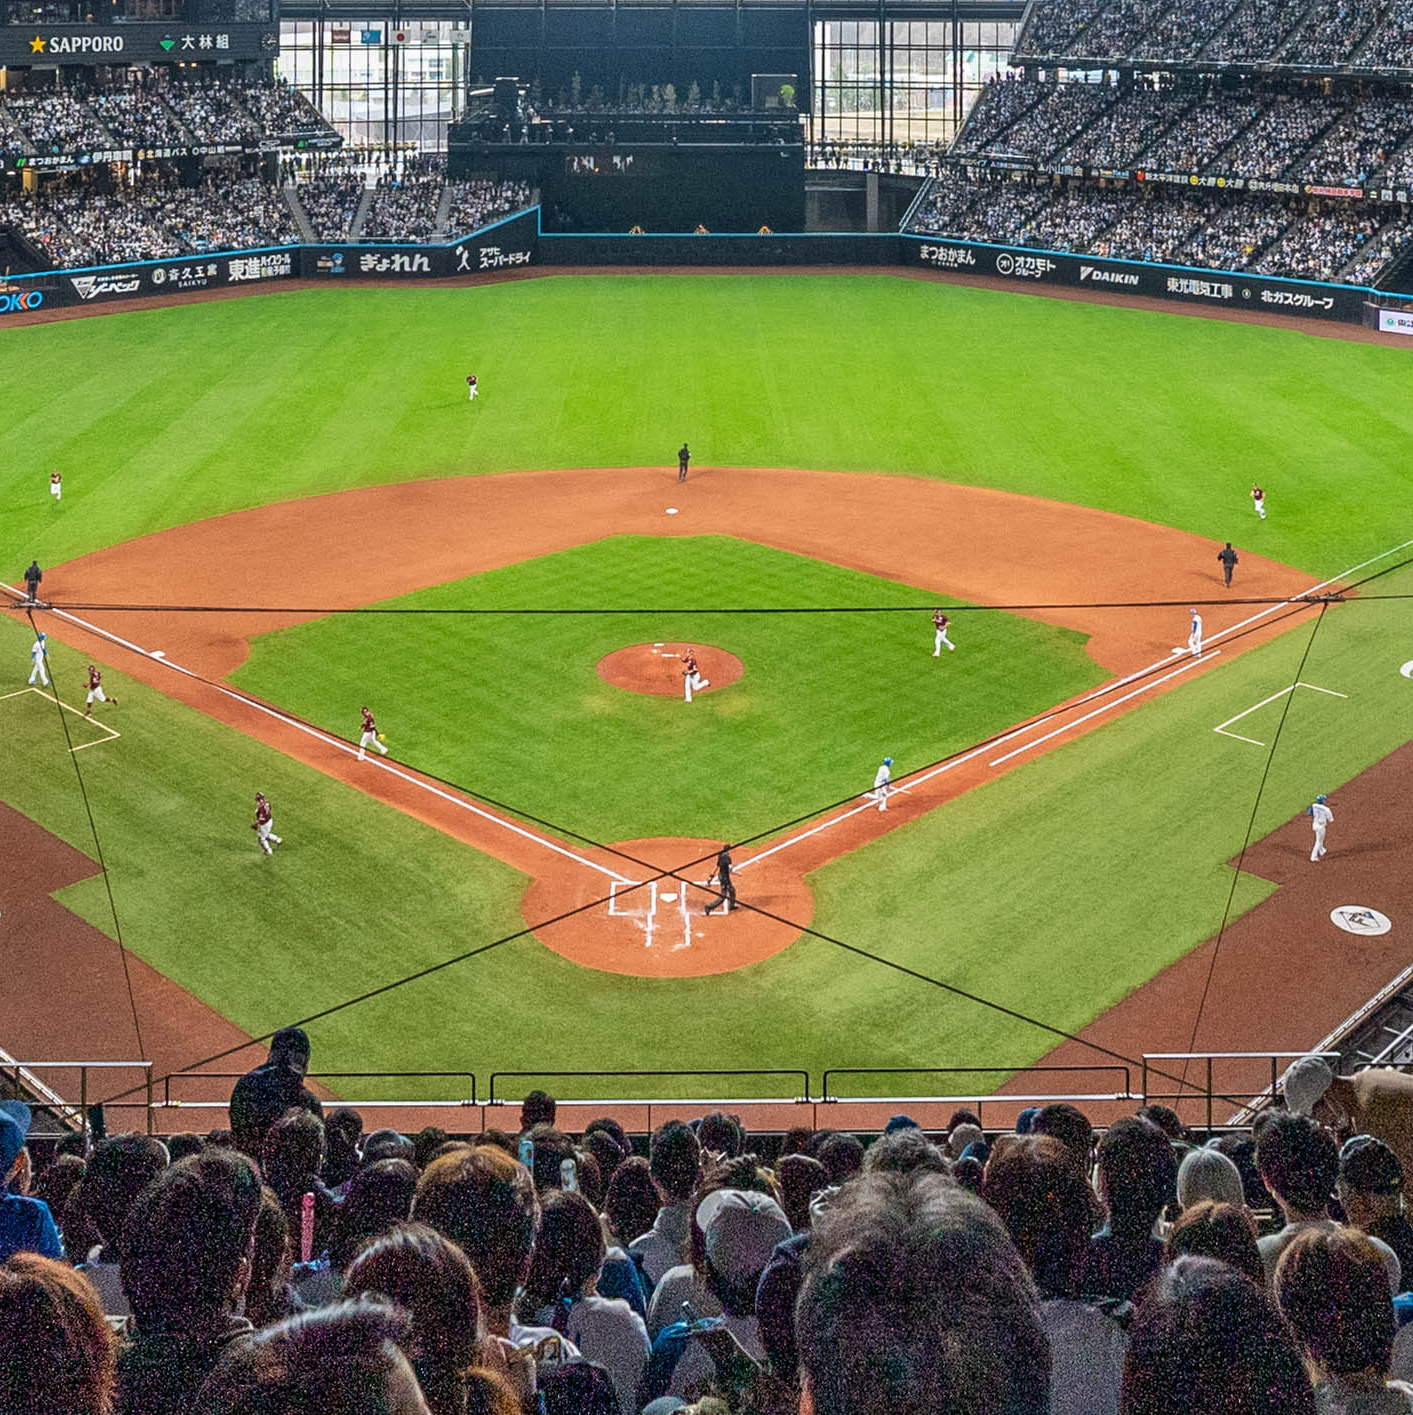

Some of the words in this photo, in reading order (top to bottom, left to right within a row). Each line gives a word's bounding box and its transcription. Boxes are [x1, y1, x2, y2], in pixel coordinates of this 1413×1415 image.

[49, 36, 124, 53] SAPPORO
[181, 34, 230, 50] 大林組
[479, 251, 531, 269] スーパードライ
[480, 247, 500, 257] アサヒ
[920, 245, 976, 265] まつおかまん
[227, 257, 261, 282] 東進
[359, 253, 431, 272] ぎょれん
[1015, 256, 1056, 272] オカモト
[1015, 268, 1042, 278] グループ
[1091, 271, 1139, 285] DAIKIN
[1260, 290, 1334, 309] 北ガスグループ
